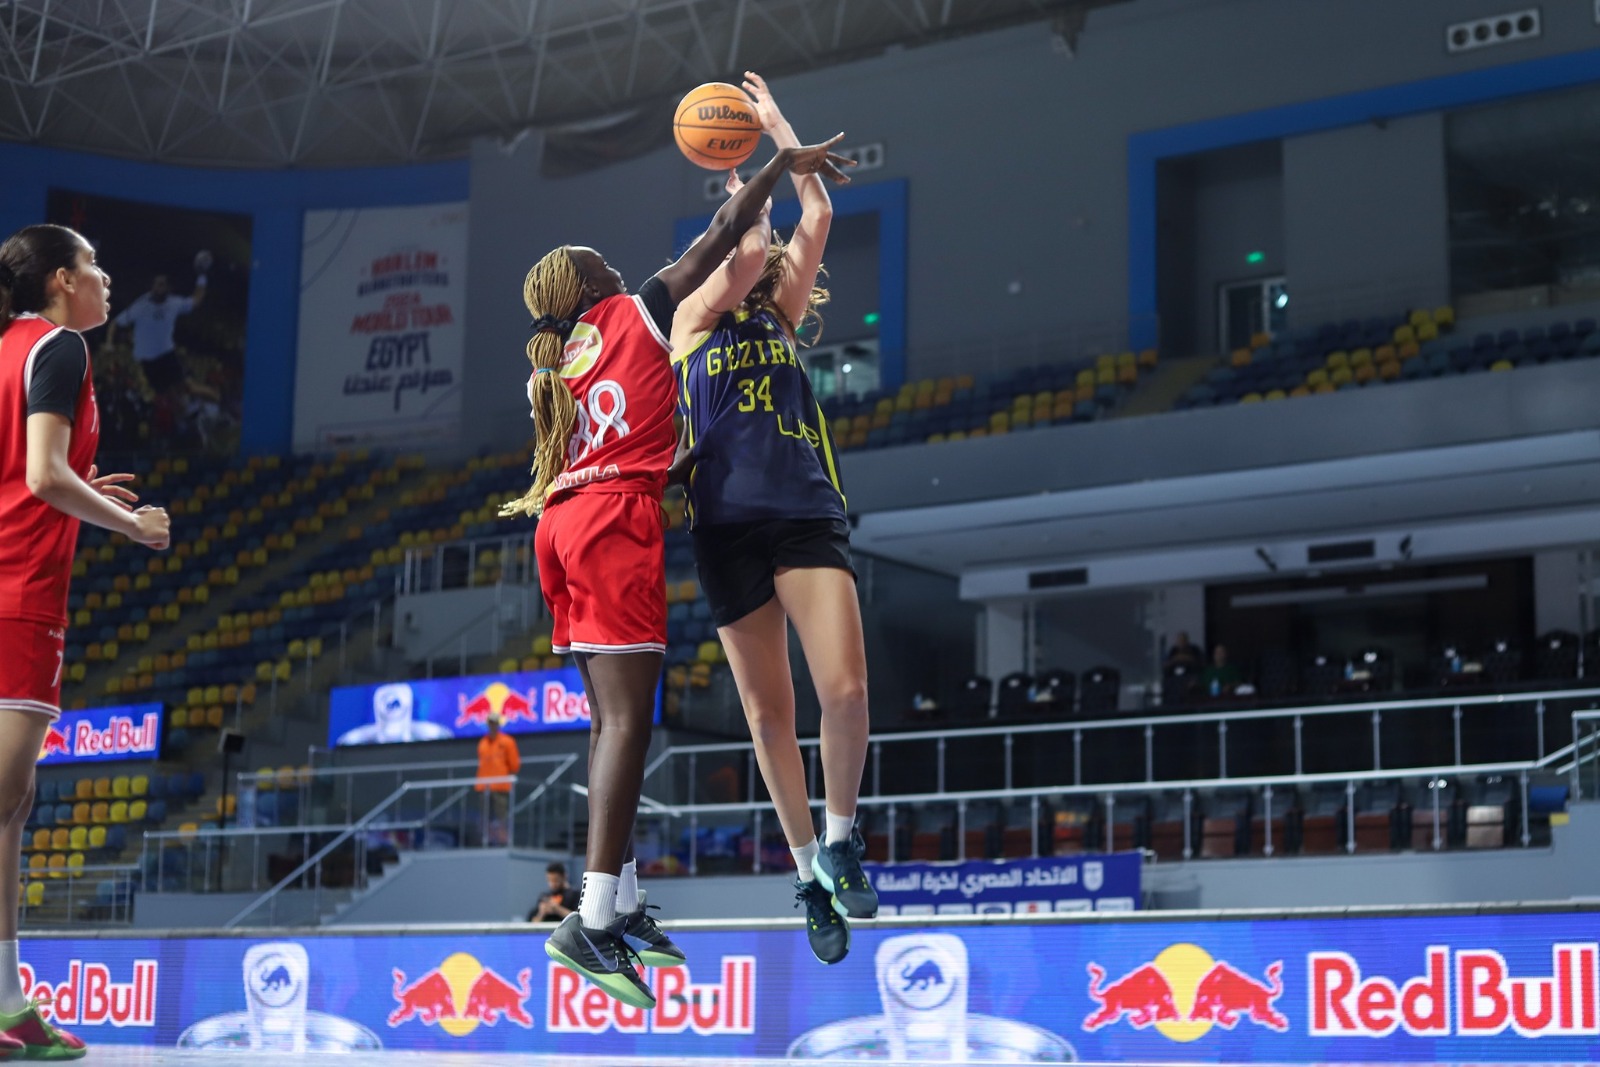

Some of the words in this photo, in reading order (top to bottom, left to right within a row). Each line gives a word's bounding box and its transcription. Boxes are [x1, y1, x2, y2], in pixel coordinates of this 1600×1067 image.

[697, 104, 754, 124] Wilson
[366, 331, 431, 370] EGYPT
[706, 339, 797, 376] GEZIRA
[738, 375, 774, 412] 34
[75, 716, 116, 755] Red
[117, 713, 157, 752] Bull
[1025, 865, 1077, 887] الاتحاد
[83, 961, 157, 1025] Bull
[654, 959, 753, 1031] Bull
[1311, 949, 1446, 1032] Red
[1459, 946, 1598, 1032] Bull
